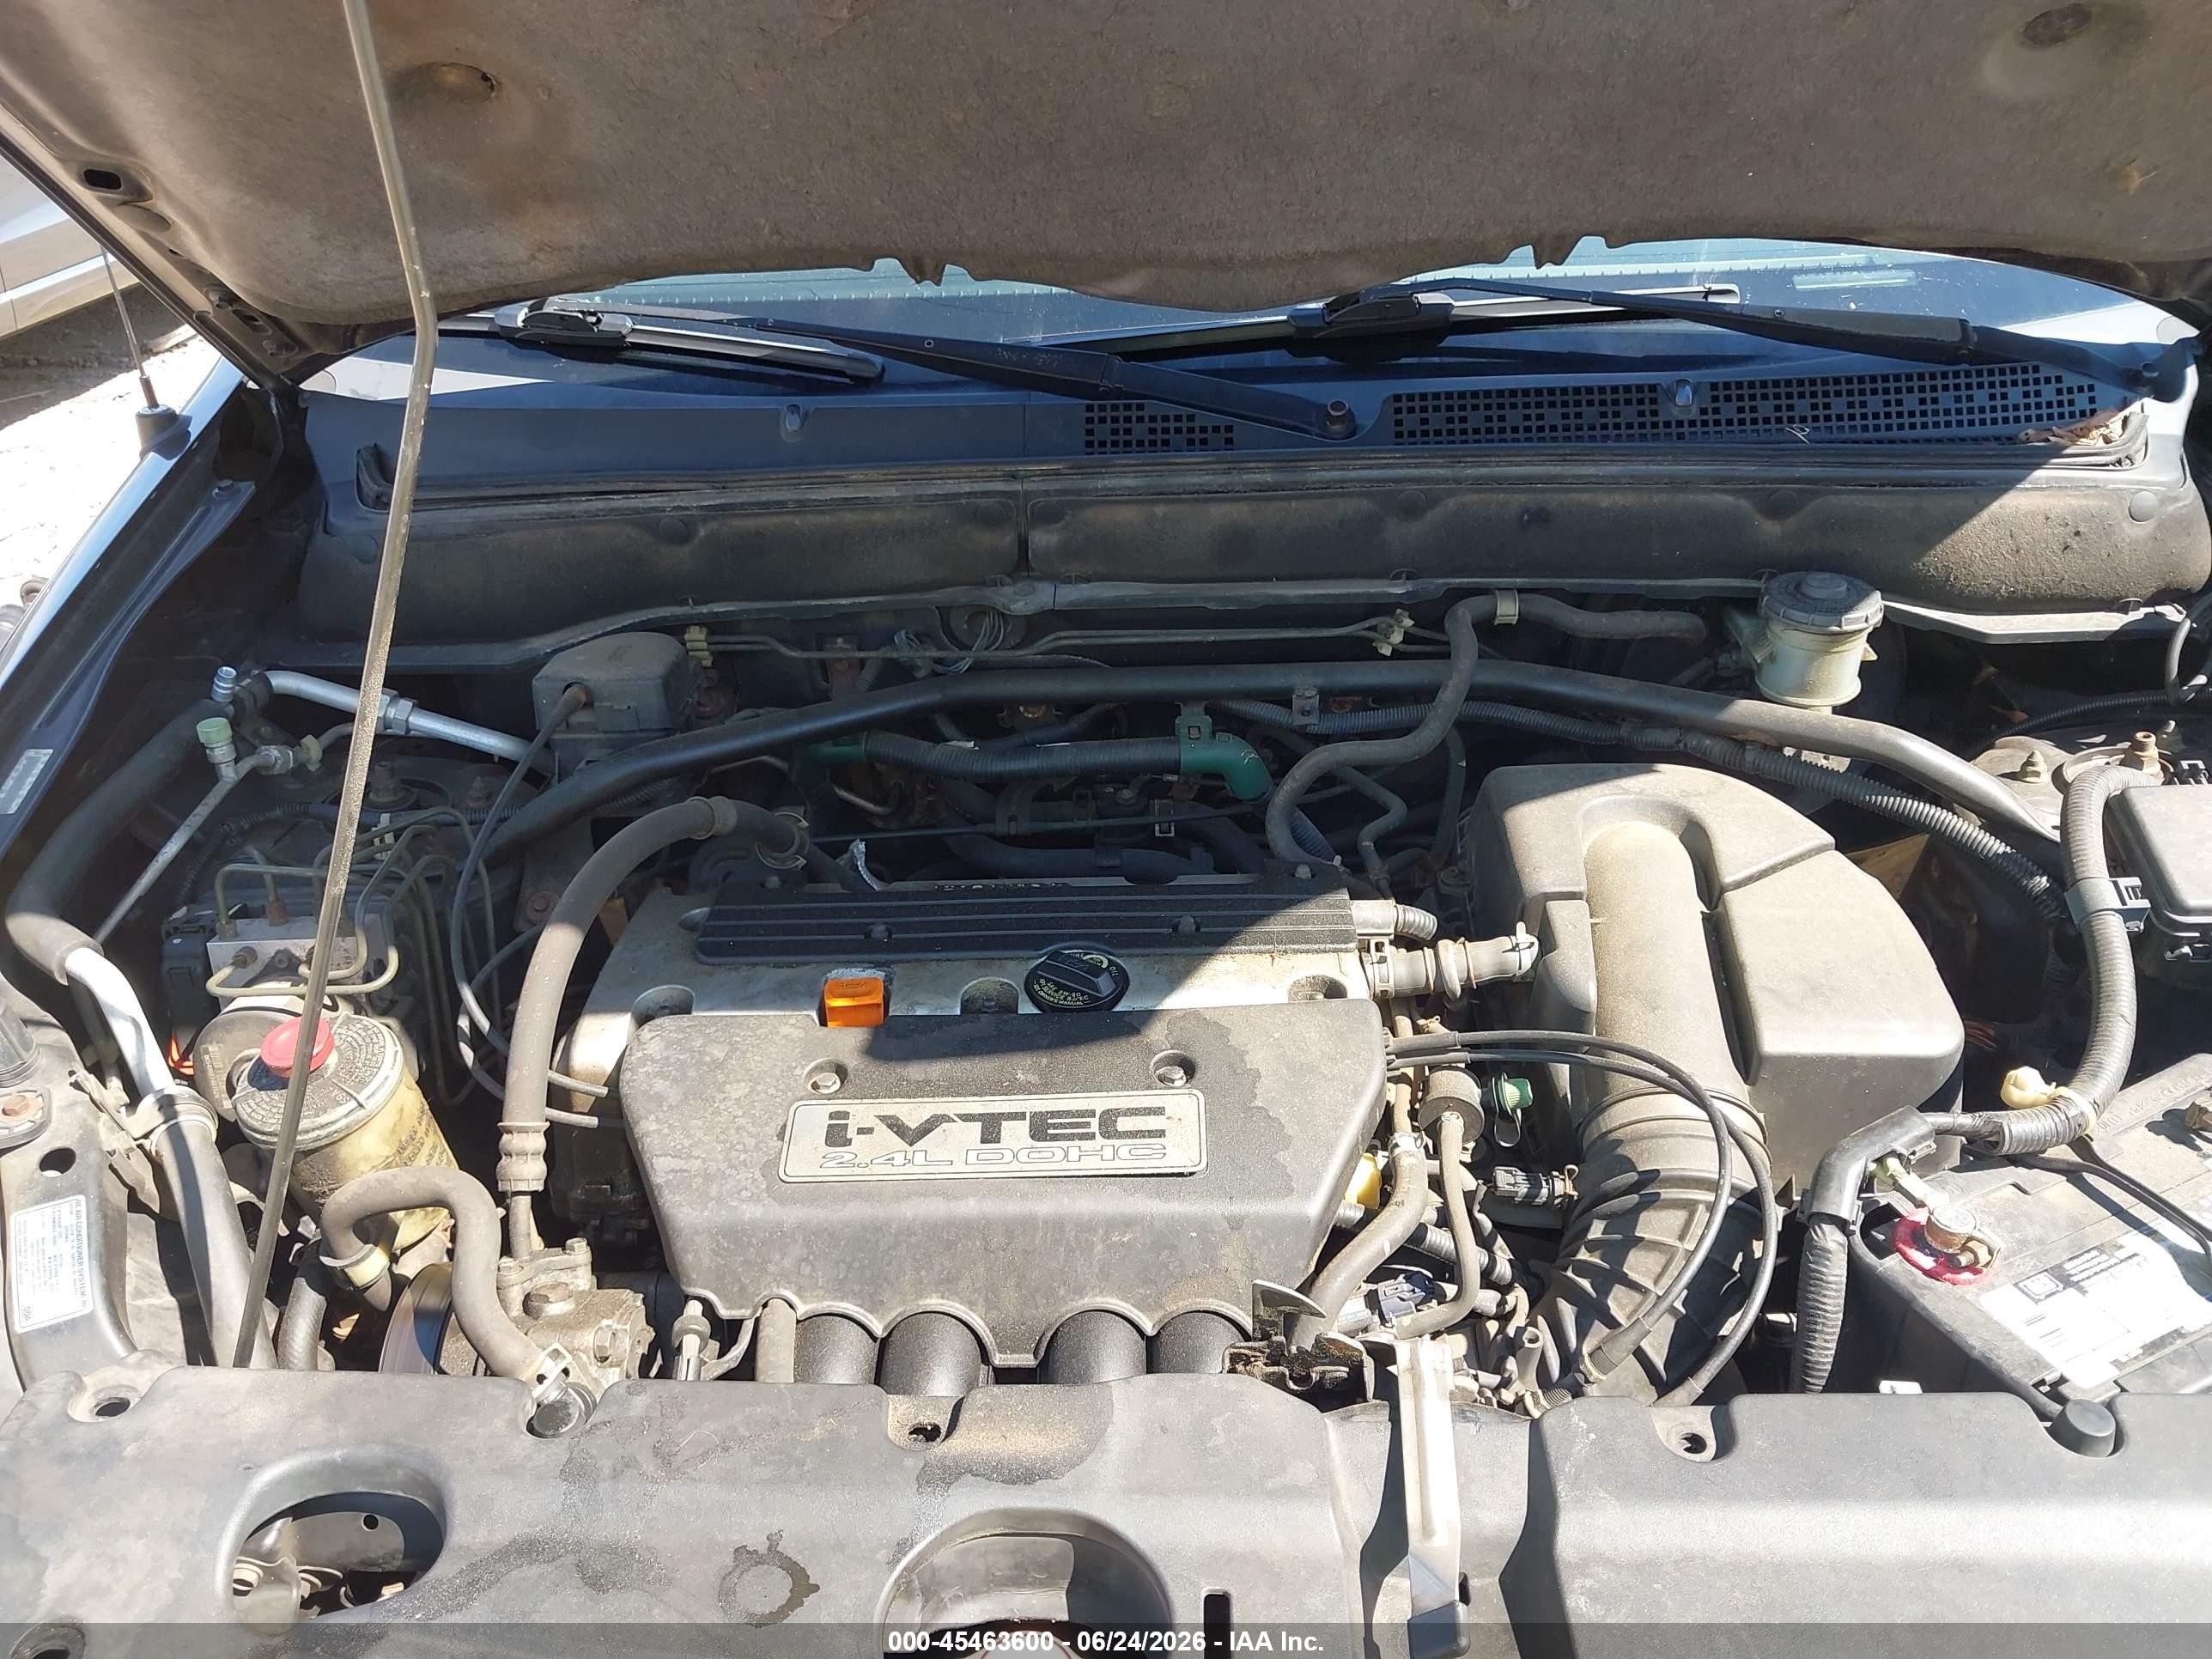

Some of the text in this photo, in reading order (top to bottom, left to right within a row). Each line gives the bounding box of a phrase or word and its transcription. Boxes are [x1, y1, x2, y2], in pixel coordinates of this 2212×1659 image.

[1109, 966, 1120, 976] OIL
[1042, 985, 1066, 1000] SERVICE
[1047, 981, 1058, 992] SAE
[824, 1106, 1166, 1148] i-VTEC
[820, 1143, 1167, 1169] 2.4L DOHC
[75, 1209, 88, 1298] AIR CONDITIONER SYSTEM
